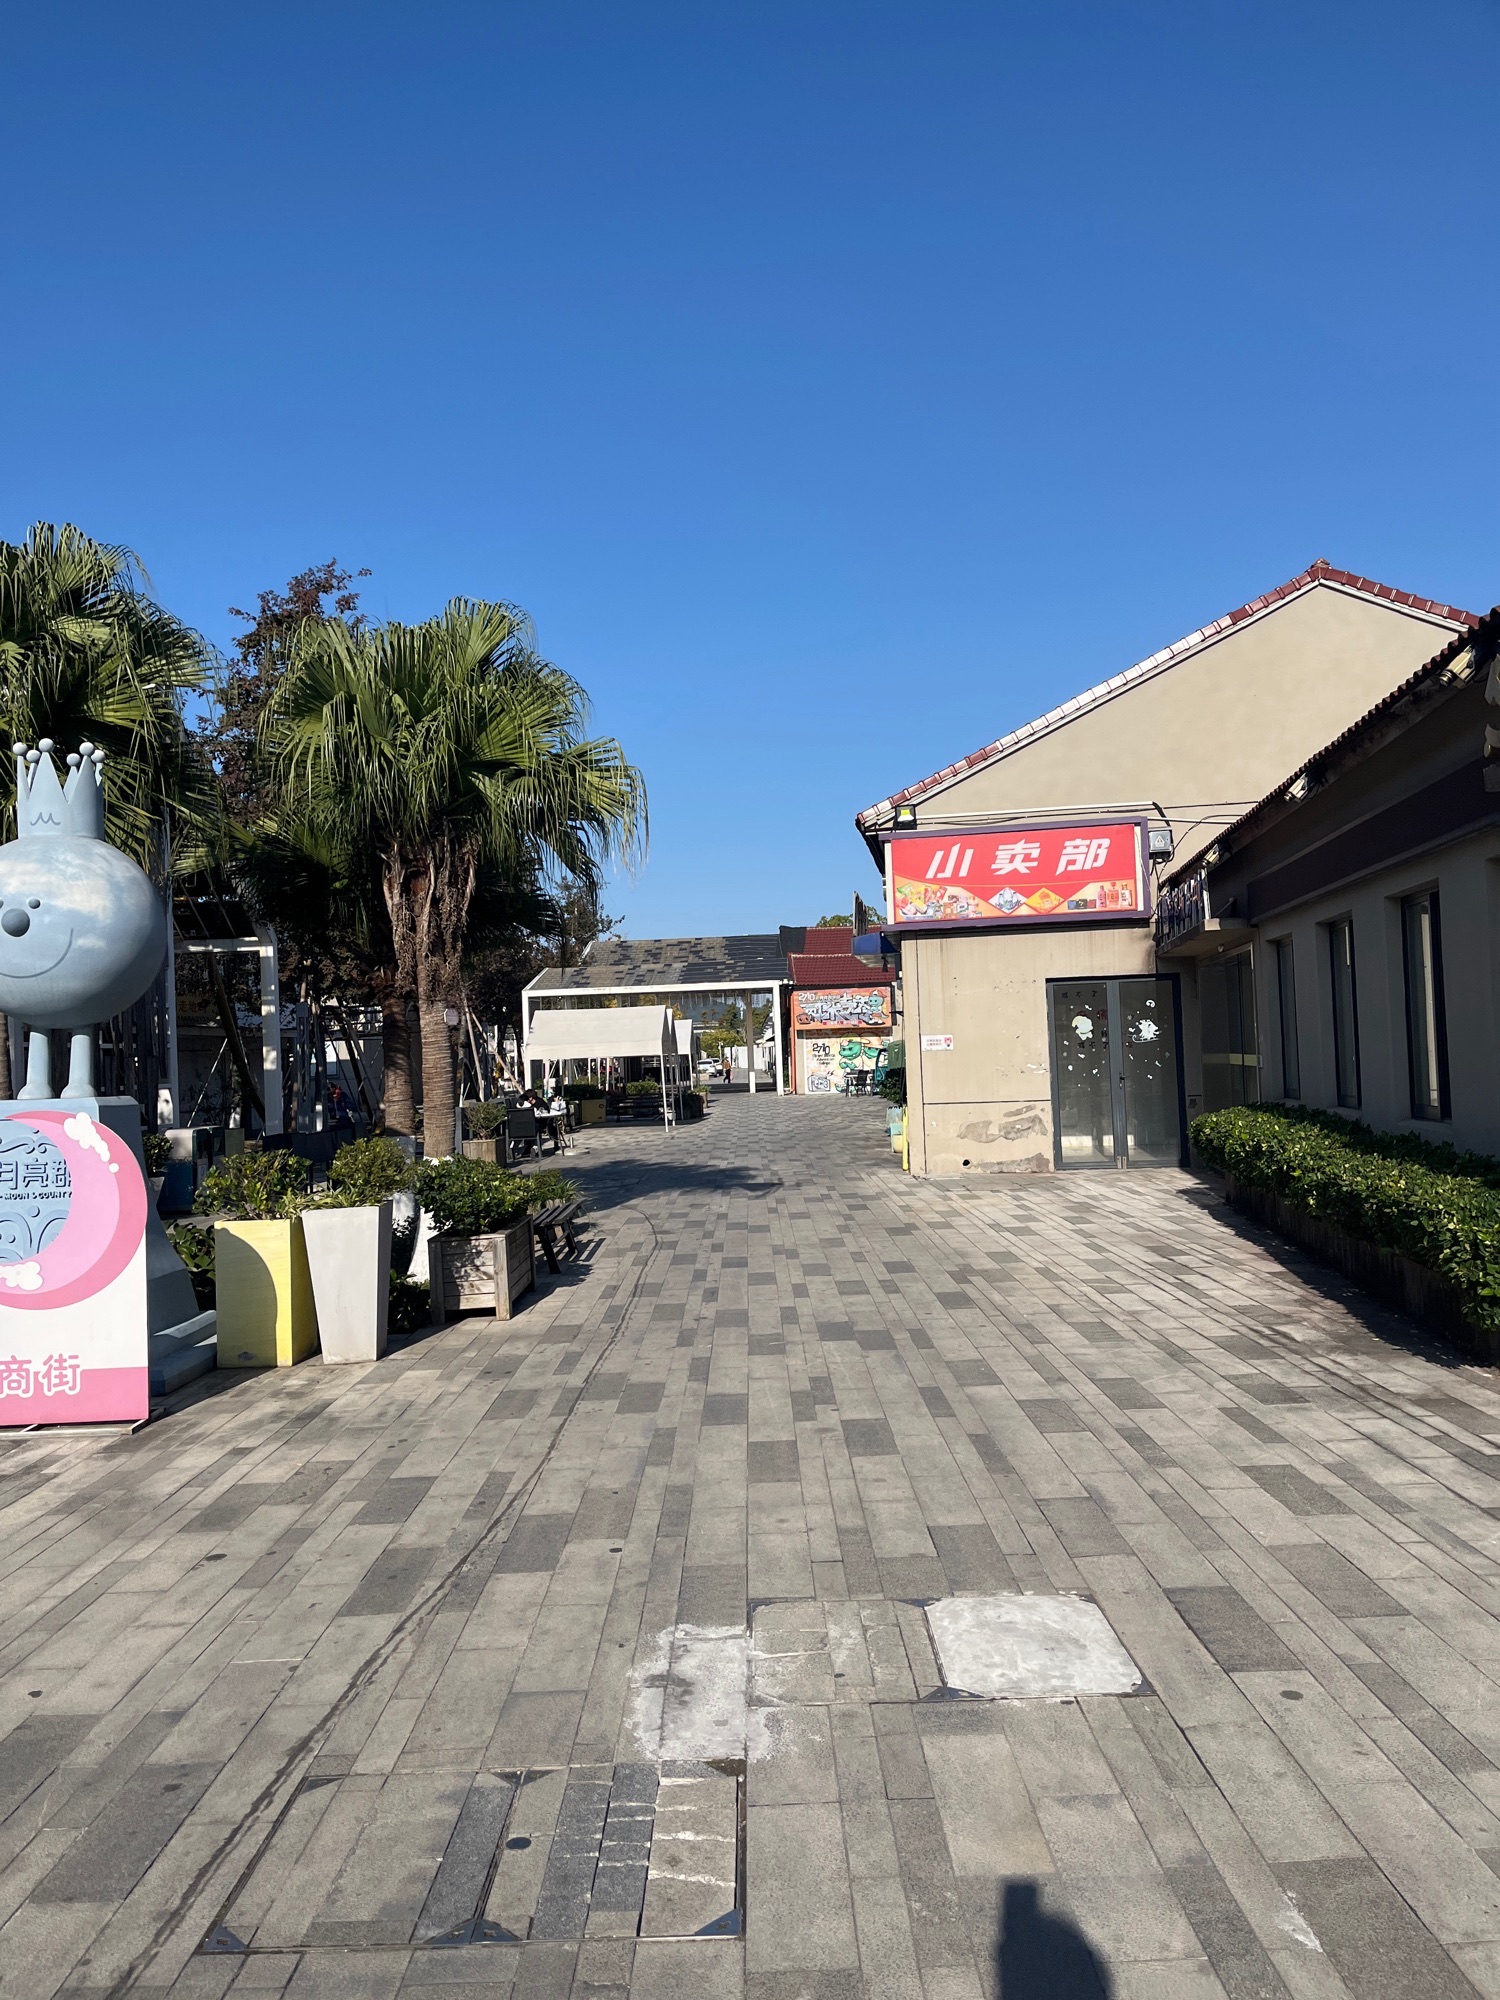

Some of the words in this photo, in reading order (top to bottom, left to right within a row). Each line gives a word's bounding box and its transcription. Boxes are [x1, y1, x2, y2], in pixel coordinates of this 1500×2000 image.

[925, 838, 1111, 879] 小卖部
[813, 1043, 831, 1055] 2710
